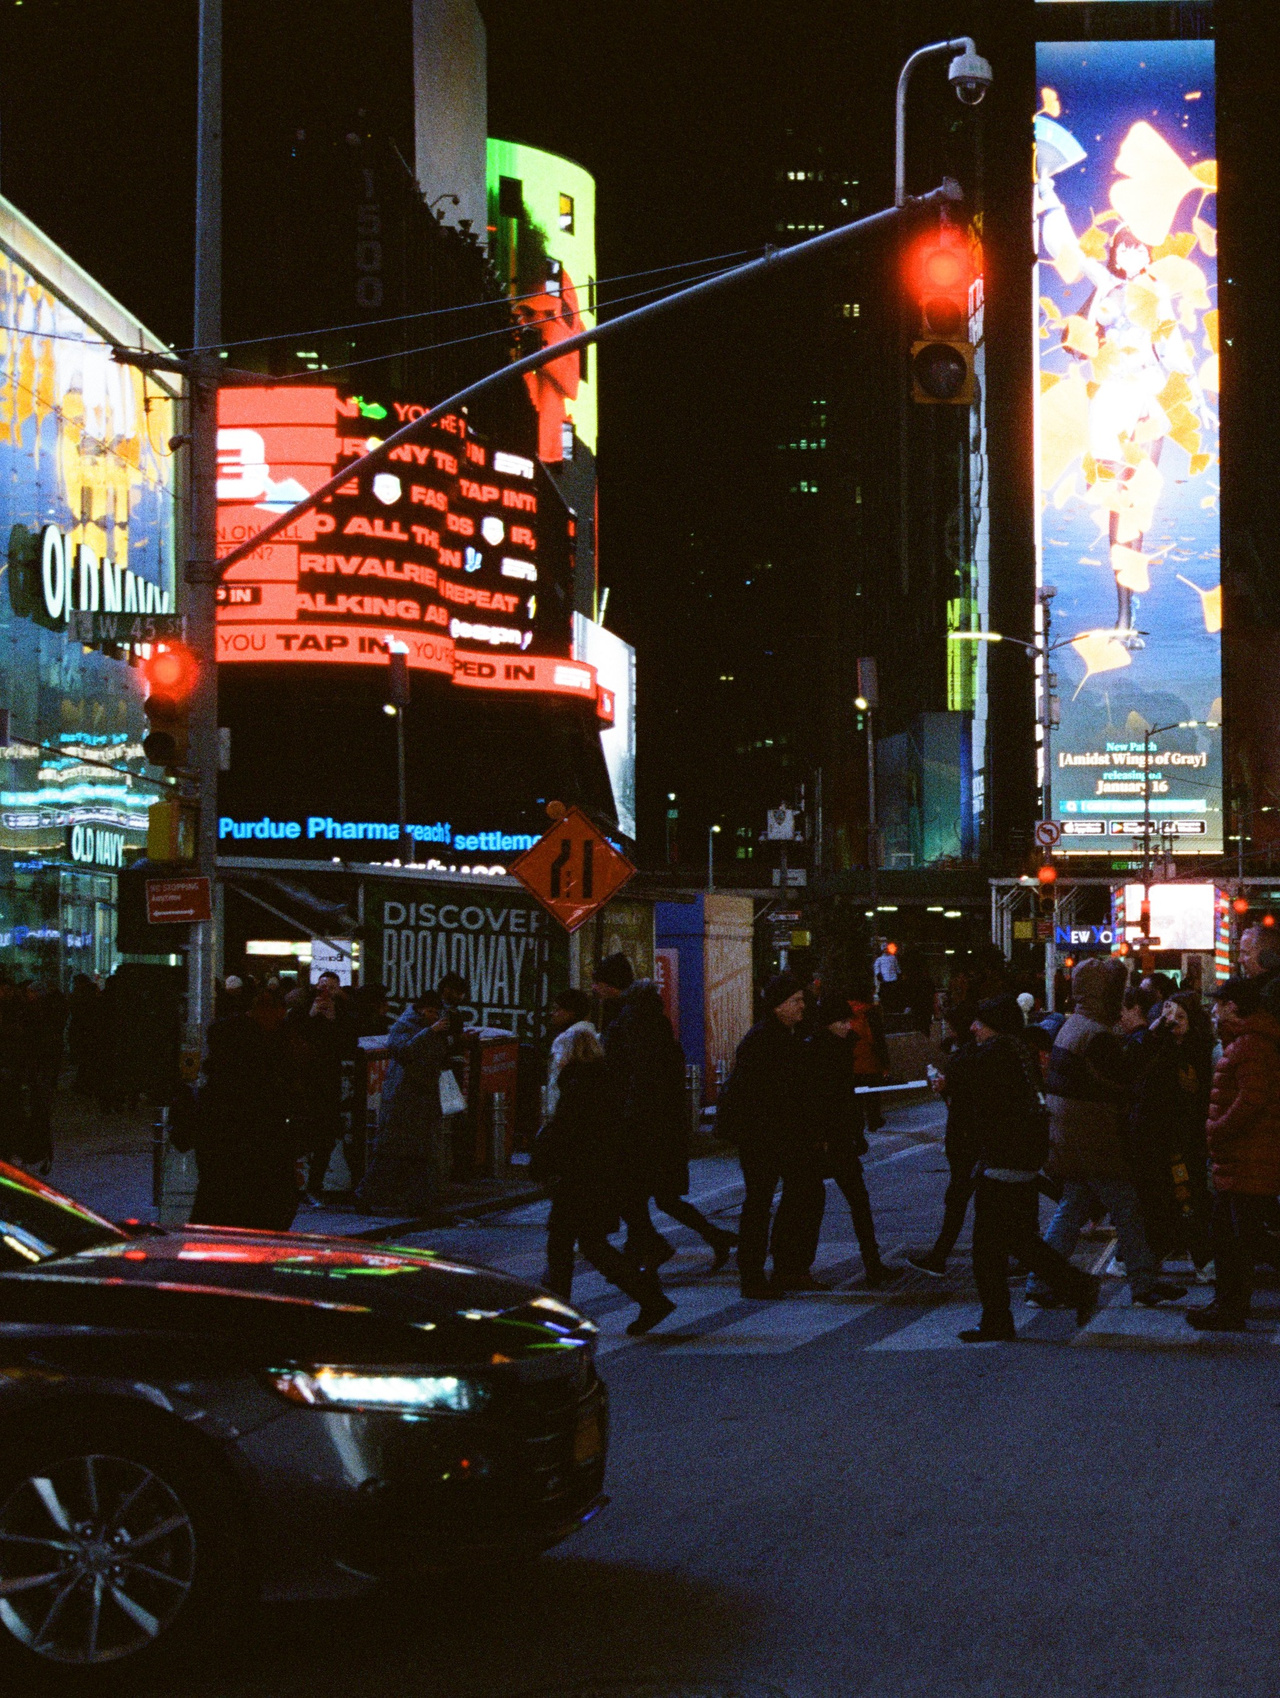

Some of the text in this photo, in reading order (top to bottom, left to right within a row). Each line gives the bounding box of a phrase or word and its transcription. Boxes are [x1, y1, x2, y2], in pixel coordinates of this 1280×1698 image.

[343, 516, 409, 541] ALL
[43, 525, 170, 628] OLD NAVY
[131, 618, 156, 640] 45
[221, 634, 267, 651] YOU
[276, 634, 349, 652] TAP
[358, 636, 389, 655] IN
[504, 665, 536, 680] IN
[1106, 742, 1128, 752] New
[1155, 752, 1170, 765] of
[1096, 781, 1169, 795] January 16
[219, 817, 301, 840] Purdue
[307, 816, 400, 840] Pharma
[71, 825, 125, 868] OLD NAVY
[1091, 925, 1114, 944] YO
